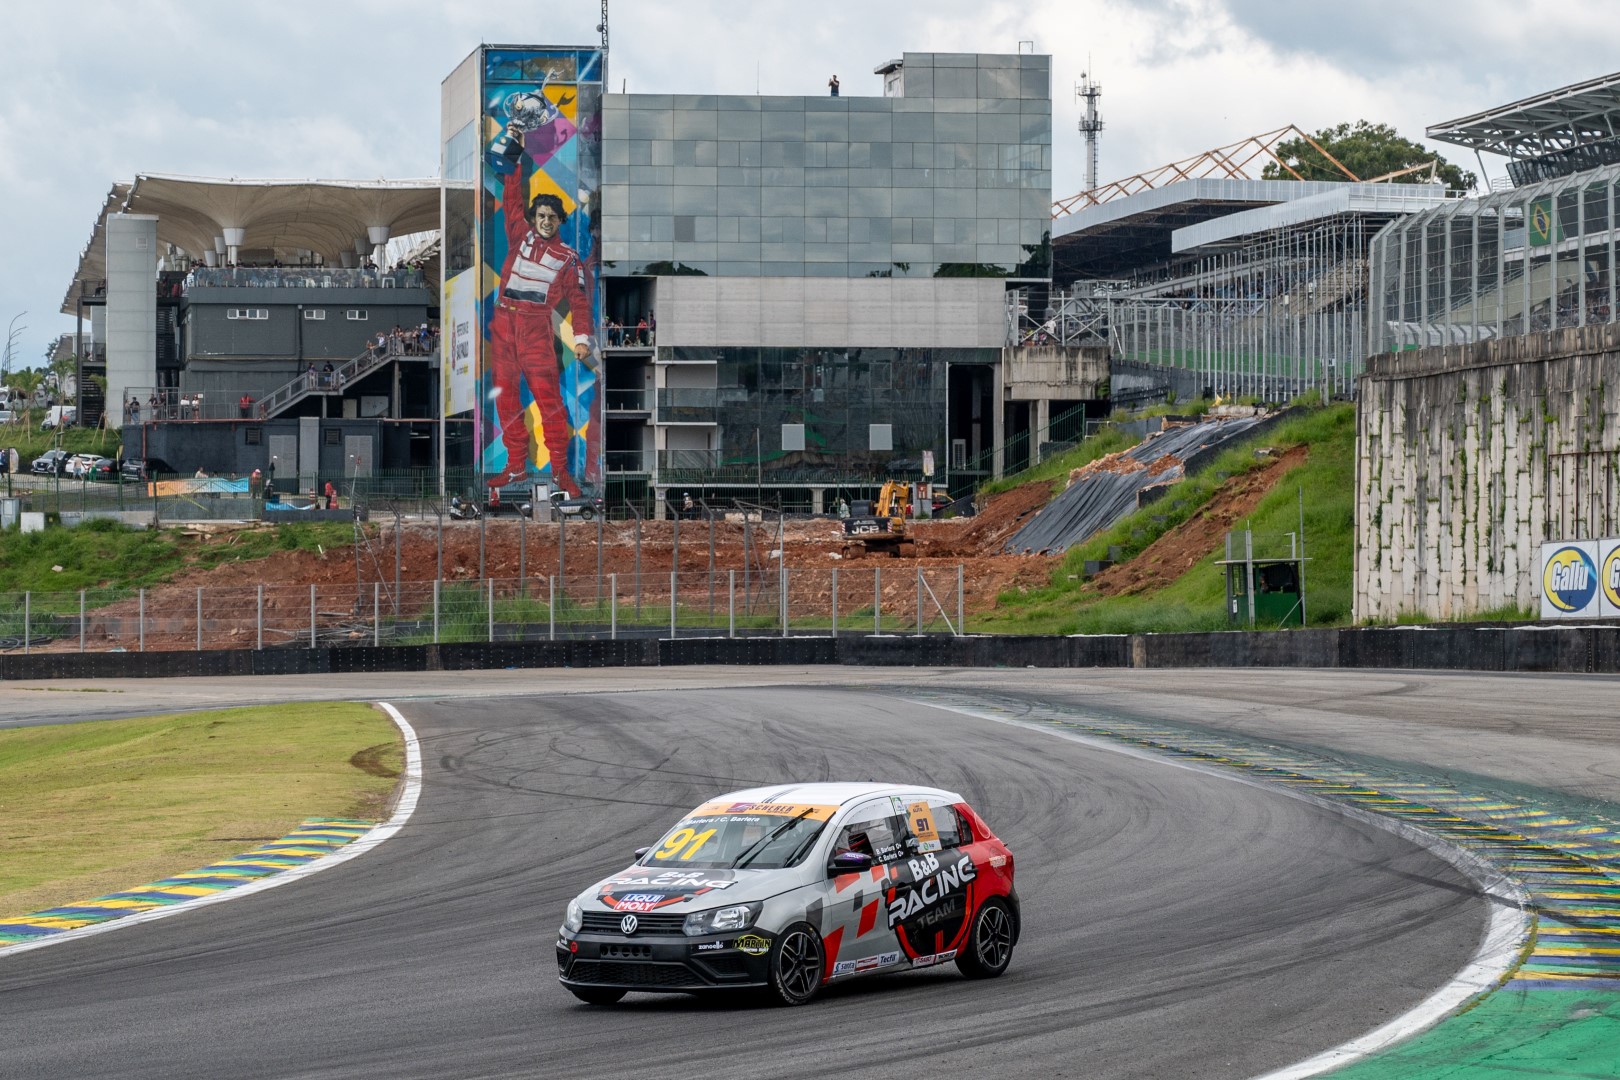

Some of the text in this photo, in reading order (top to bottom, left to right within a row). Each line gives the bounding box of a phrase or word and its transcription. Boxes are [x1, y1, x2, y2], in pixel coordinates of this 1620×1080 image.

[916, 818, 930, 832] 91
[655, 828, 717, 860] 91
[908, 852, 939, 882] B&B
[606, 877, 736, 889] RACING
[888, 855, 976, 927] RACING
[616, 902, 653, 911] MOLY
[624, 894, 662, 902] LIQUI
[917, 898, 955, 929] TEAM
